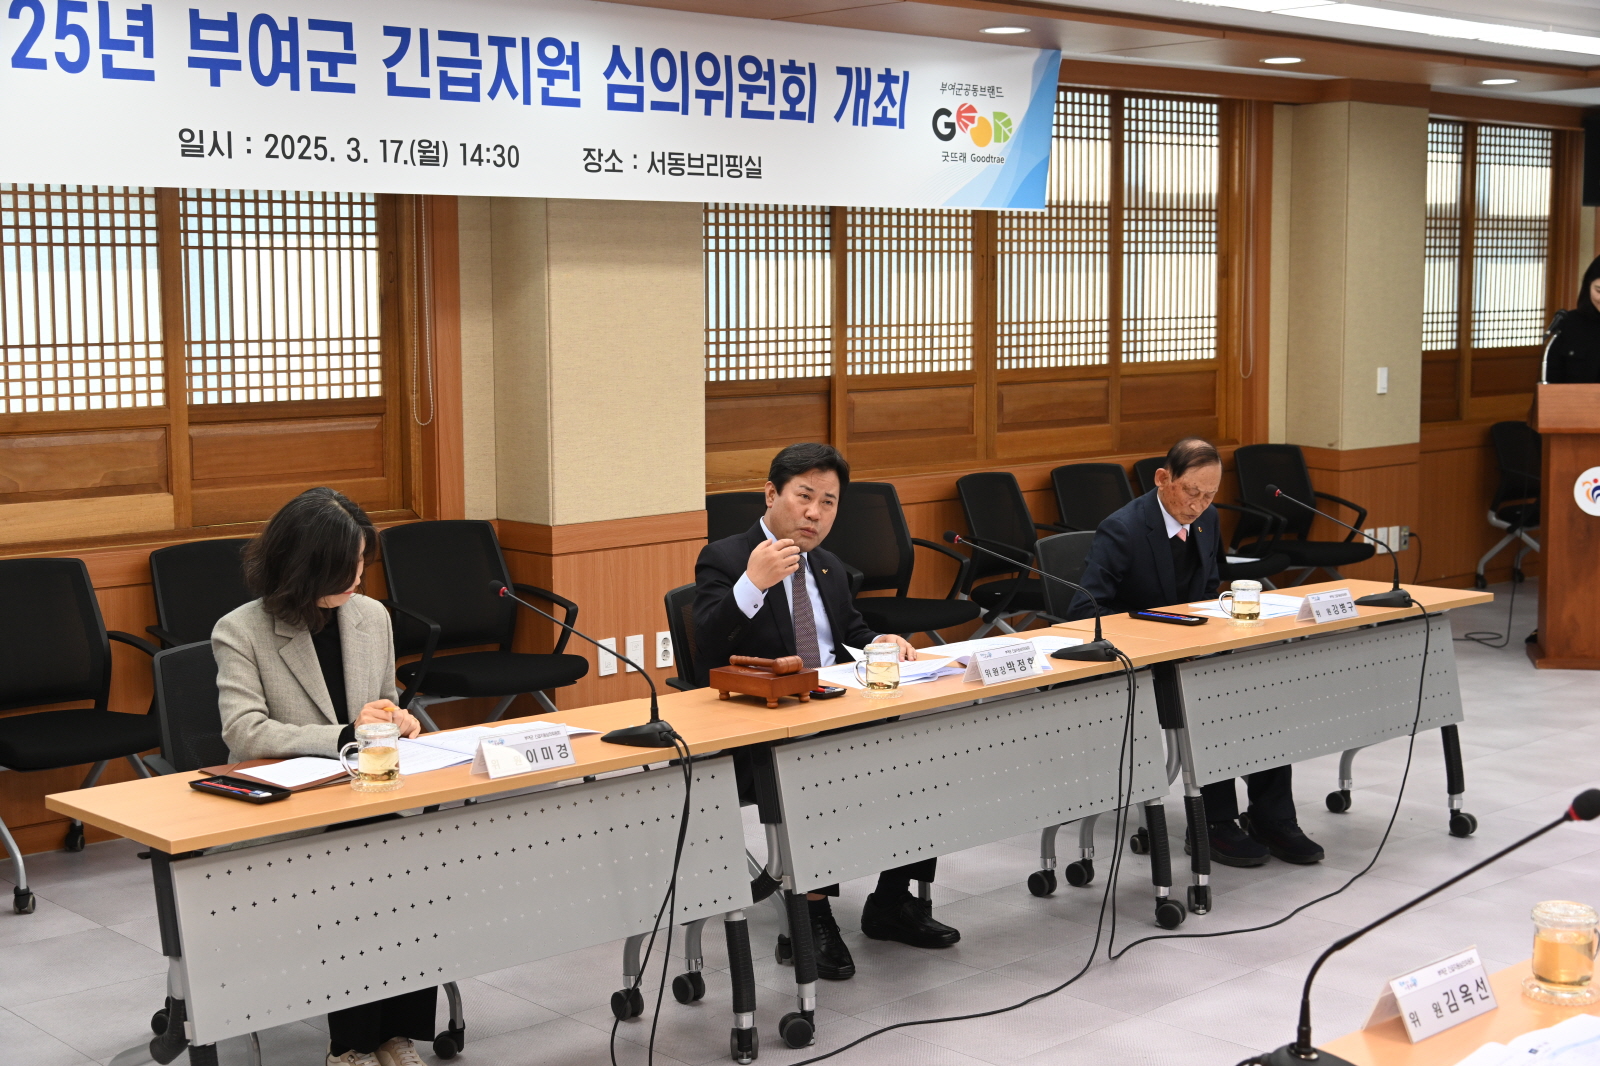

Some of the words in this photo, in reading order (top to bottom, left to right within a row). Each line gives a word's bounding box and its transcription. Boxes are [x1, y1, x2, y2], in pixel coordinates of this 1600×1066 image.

[8, 0, 156, 82] 25년
[187, 7, 357, 95] 부여군
[381, 24, 581, 109] 긴급지원
[602, 43, 817, 124] 심의위원회
[833, 65, 910, 130] 개최
[939, 81, 1005, 99] 부여군공동브랜드
[178, 127, 233, 160] 일시
[264, 133, 336, 163] 2025.
[346, 137, 369, 164] 3.
[379, 138, 449, 168] 17.(월)
[459, 142, 520, 168] 14:30
[941, 151, 967, 164] 굿뜨래
[970, 153, 1005, 164] Goodtrae
[582, 147, 624, 174] 장소
[646, 150, 763, 180] 서동브리핑실
[984, 666, 1006, 678] 위원장
[525, 743, 569, 764] 이미경
[1442, 977, 1490, 1014] 김옥선
